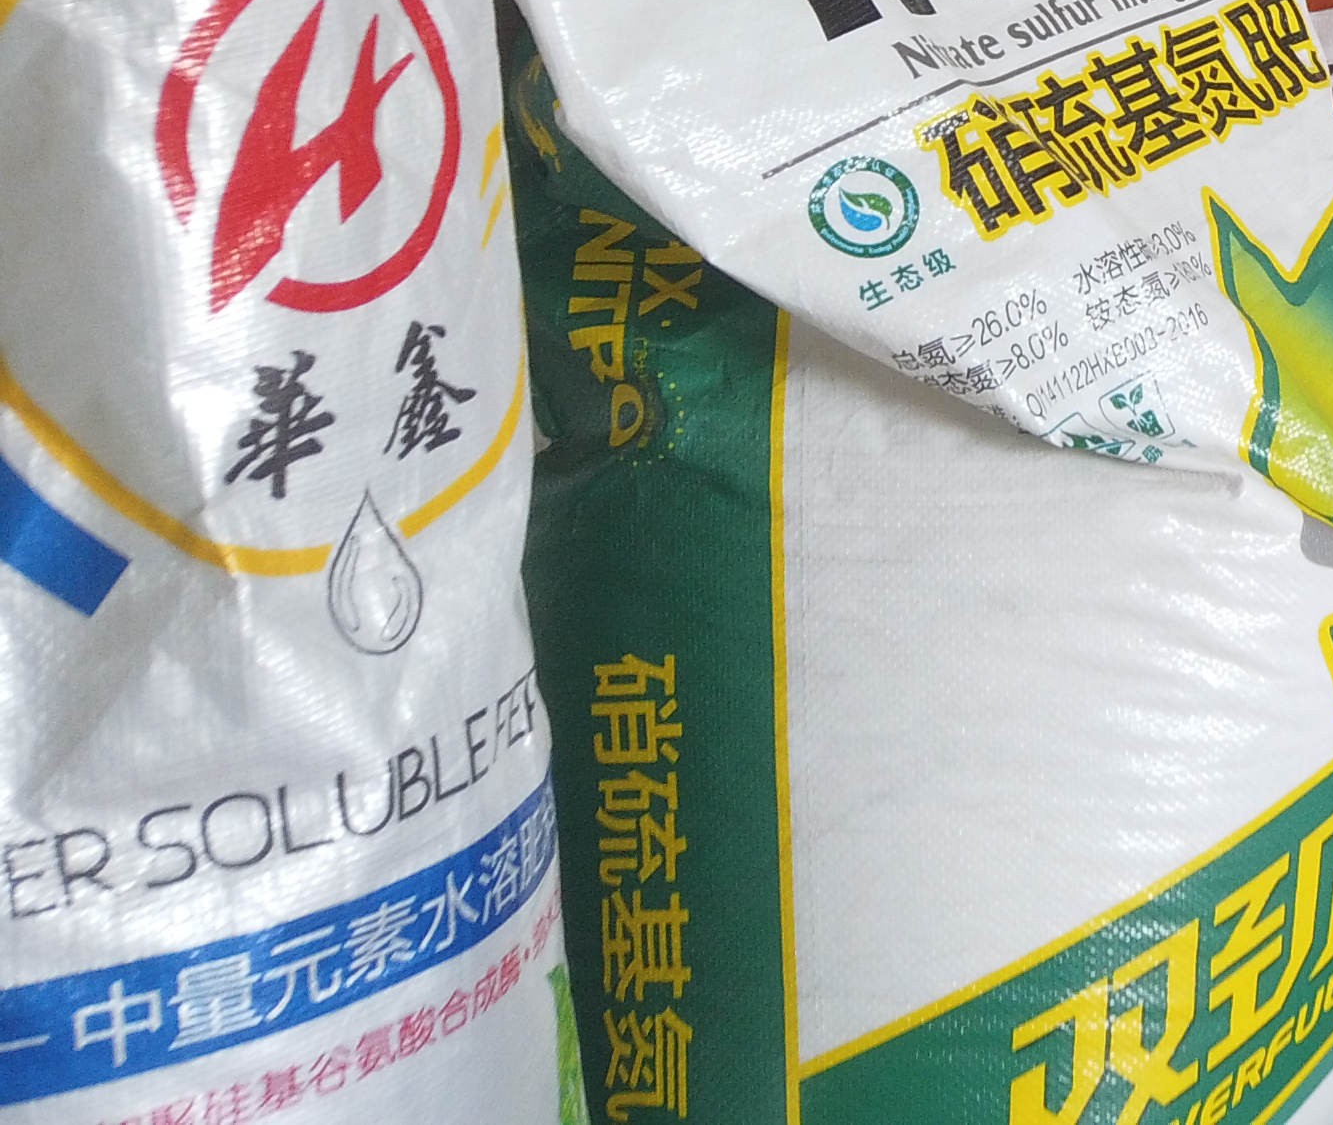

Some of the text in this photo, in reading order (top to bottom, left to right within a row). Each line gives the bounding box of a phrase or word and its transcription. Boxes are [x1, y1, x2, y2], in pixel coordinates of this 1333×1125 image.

[859, 248, 957, 312] 生态级
[922, 321, 1070, 396] 态氮≥8.0%
[137, 708, 489, 890] SOLUBLE
[591, 653, 693, 1122] 硝硫基氮
